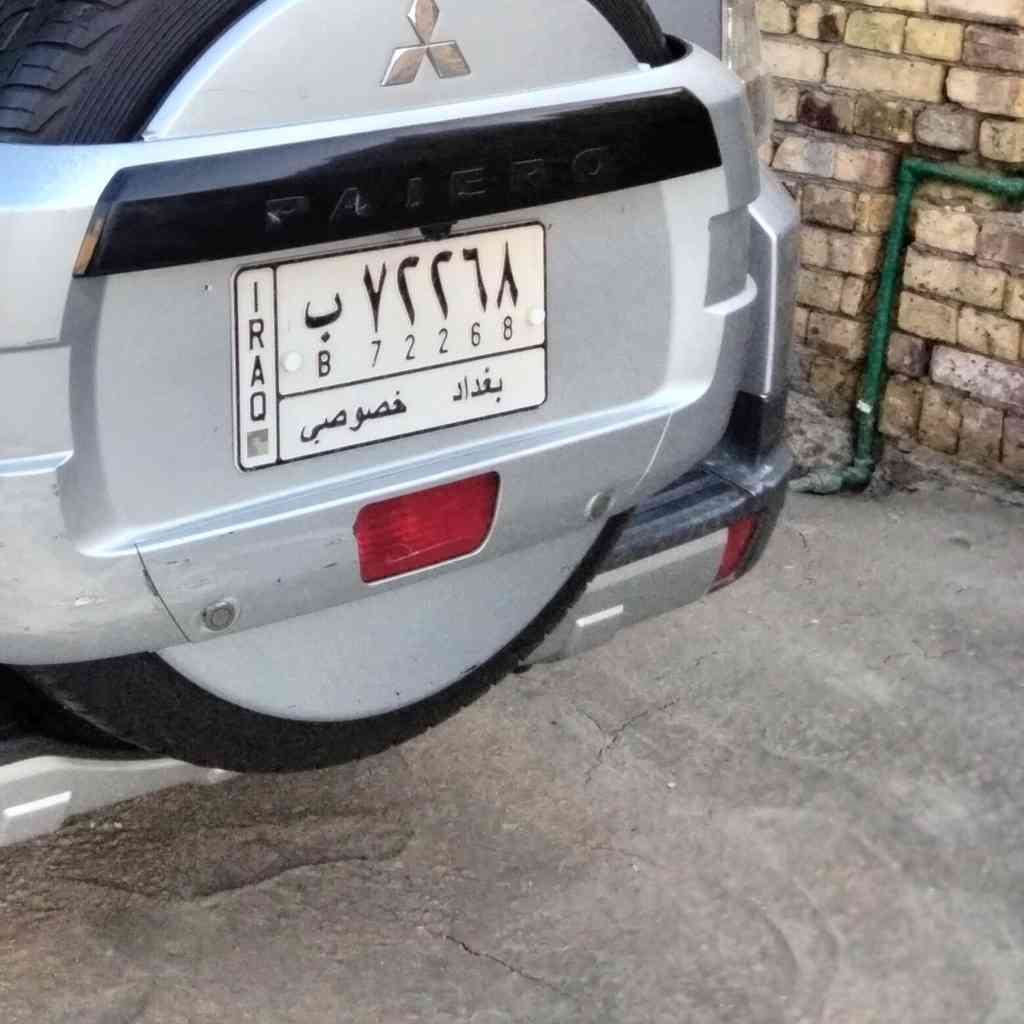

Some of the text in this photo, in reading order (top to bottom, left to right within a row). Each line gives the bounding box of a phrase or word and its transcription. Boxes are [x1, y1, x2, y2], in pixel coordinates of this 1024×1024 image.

[247, 280, 267, 422] IRAQ
[317, 350, 331, 378] B
[452, 366, 504, 403] بغداد
